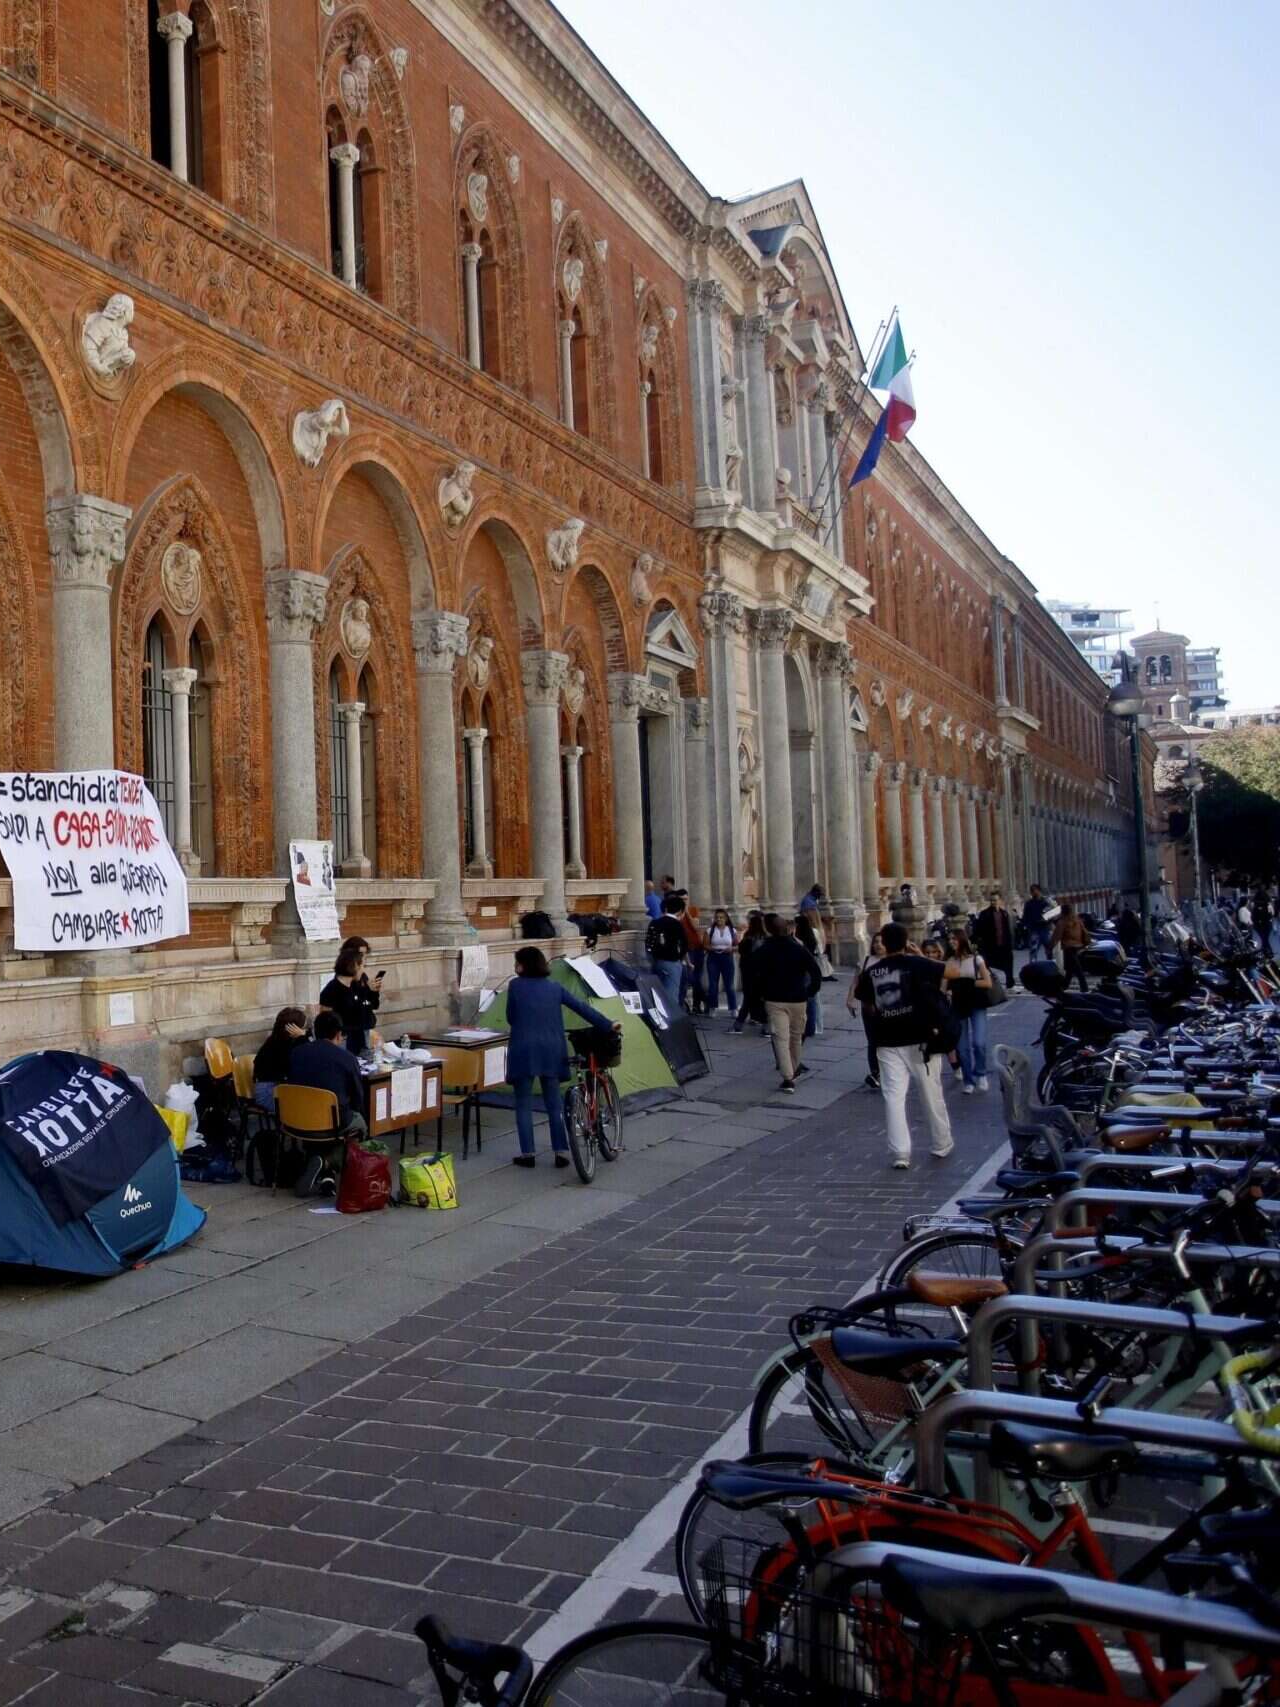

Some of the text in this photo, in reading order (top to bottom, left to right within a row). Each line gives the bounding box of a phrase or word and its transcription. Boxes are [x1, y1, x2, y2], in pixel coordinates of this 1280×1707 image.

[35, 816, 50, 850] A
[42, 859, 79, 889] NON
[90, 861, 117, 885] alla
[52, 908, 122, 943] CAMBIARE
[870, 967, 889, 977] FUN
[120, 1201, 152, 1218] Quechua
